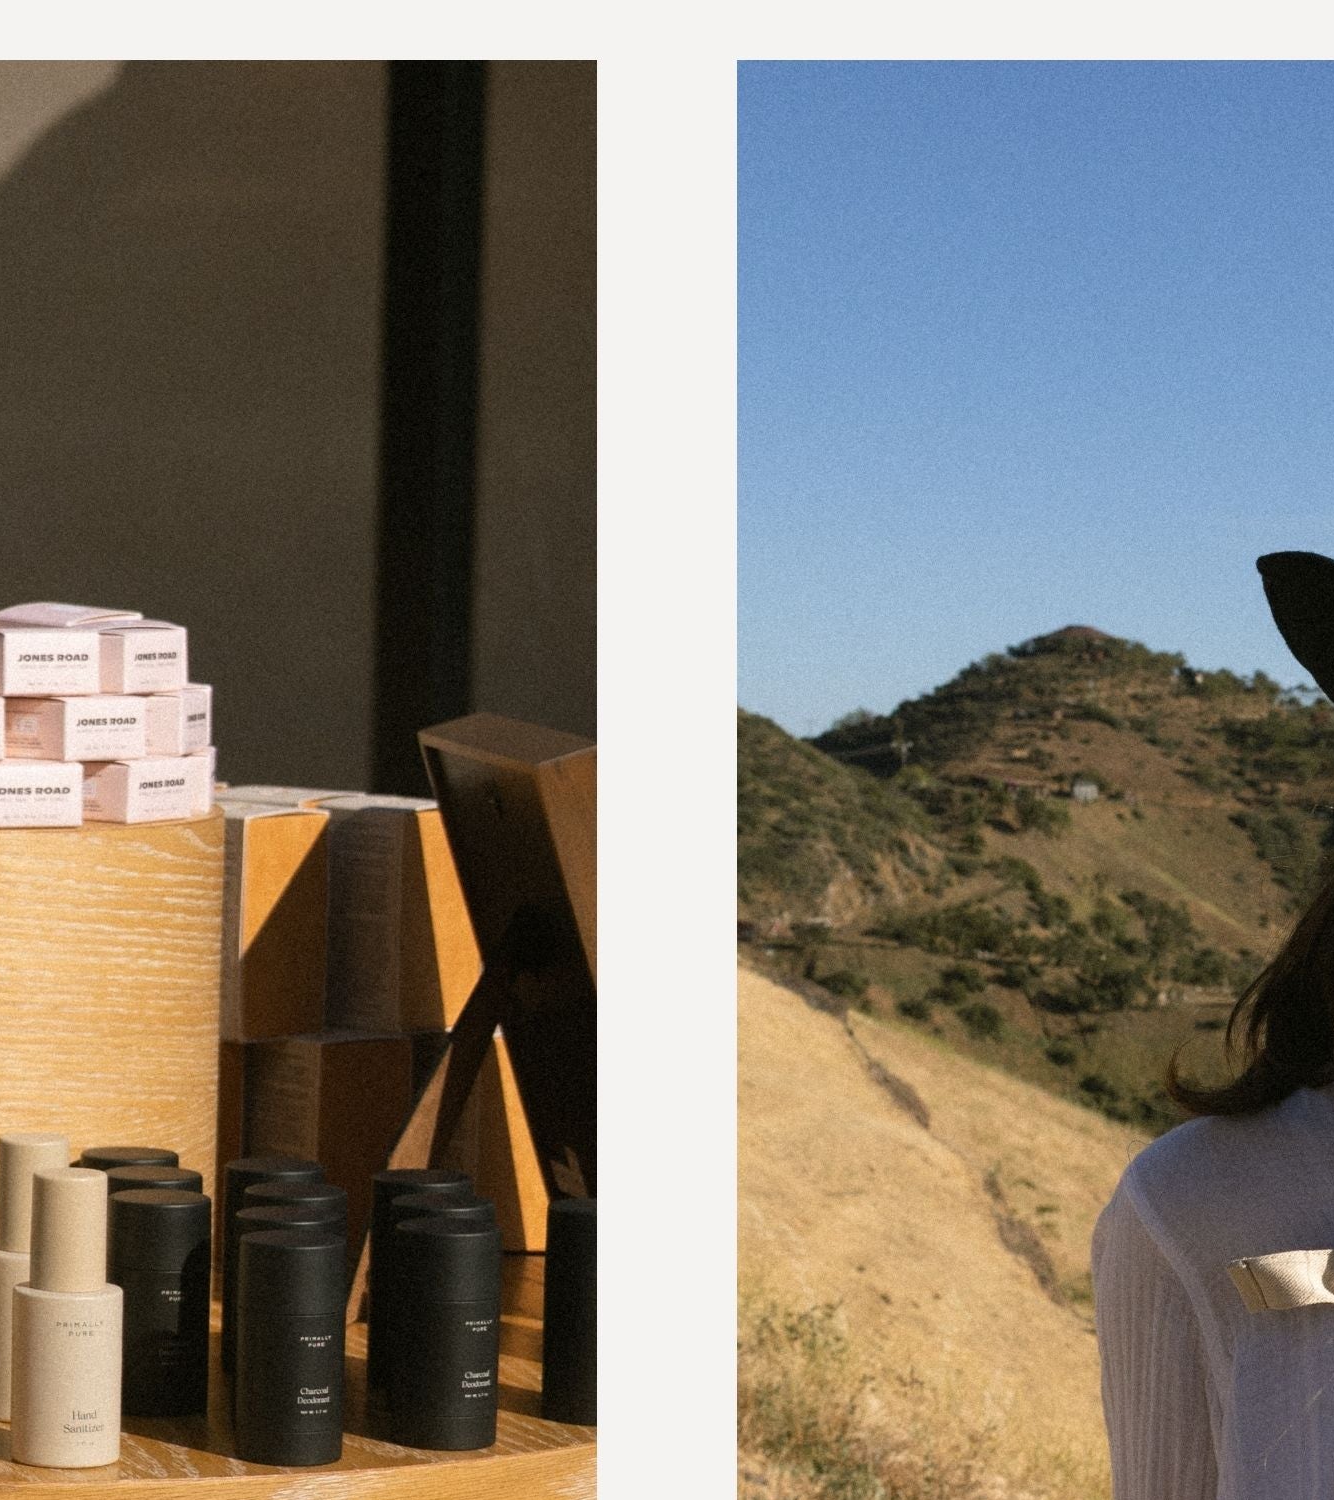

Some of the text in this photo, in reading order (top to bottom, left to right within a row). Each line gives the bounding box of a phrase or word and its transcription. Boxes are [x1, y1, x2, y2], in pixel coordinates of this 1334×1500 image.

[18, 653, 89, 662] JONES ROAD
[134, 651, 177, 661] JONES ROAD
[76, 716, 137, 726] JONES ROAD
[139, 778, 185, 789] JONES ROAD
[35, 787, 71, 795] ROAD
[464, 1370, 490, 1380] Charcoal
[461, 1380, 491, 1389] Deodorant
[300, 1386, 329, 1395] Charcoal
[297, 1396, 330, 1405] Deodorant
[72, 1410, 97, 1420] Hand
[63, 1424, 105, 1434] Sanitizer
